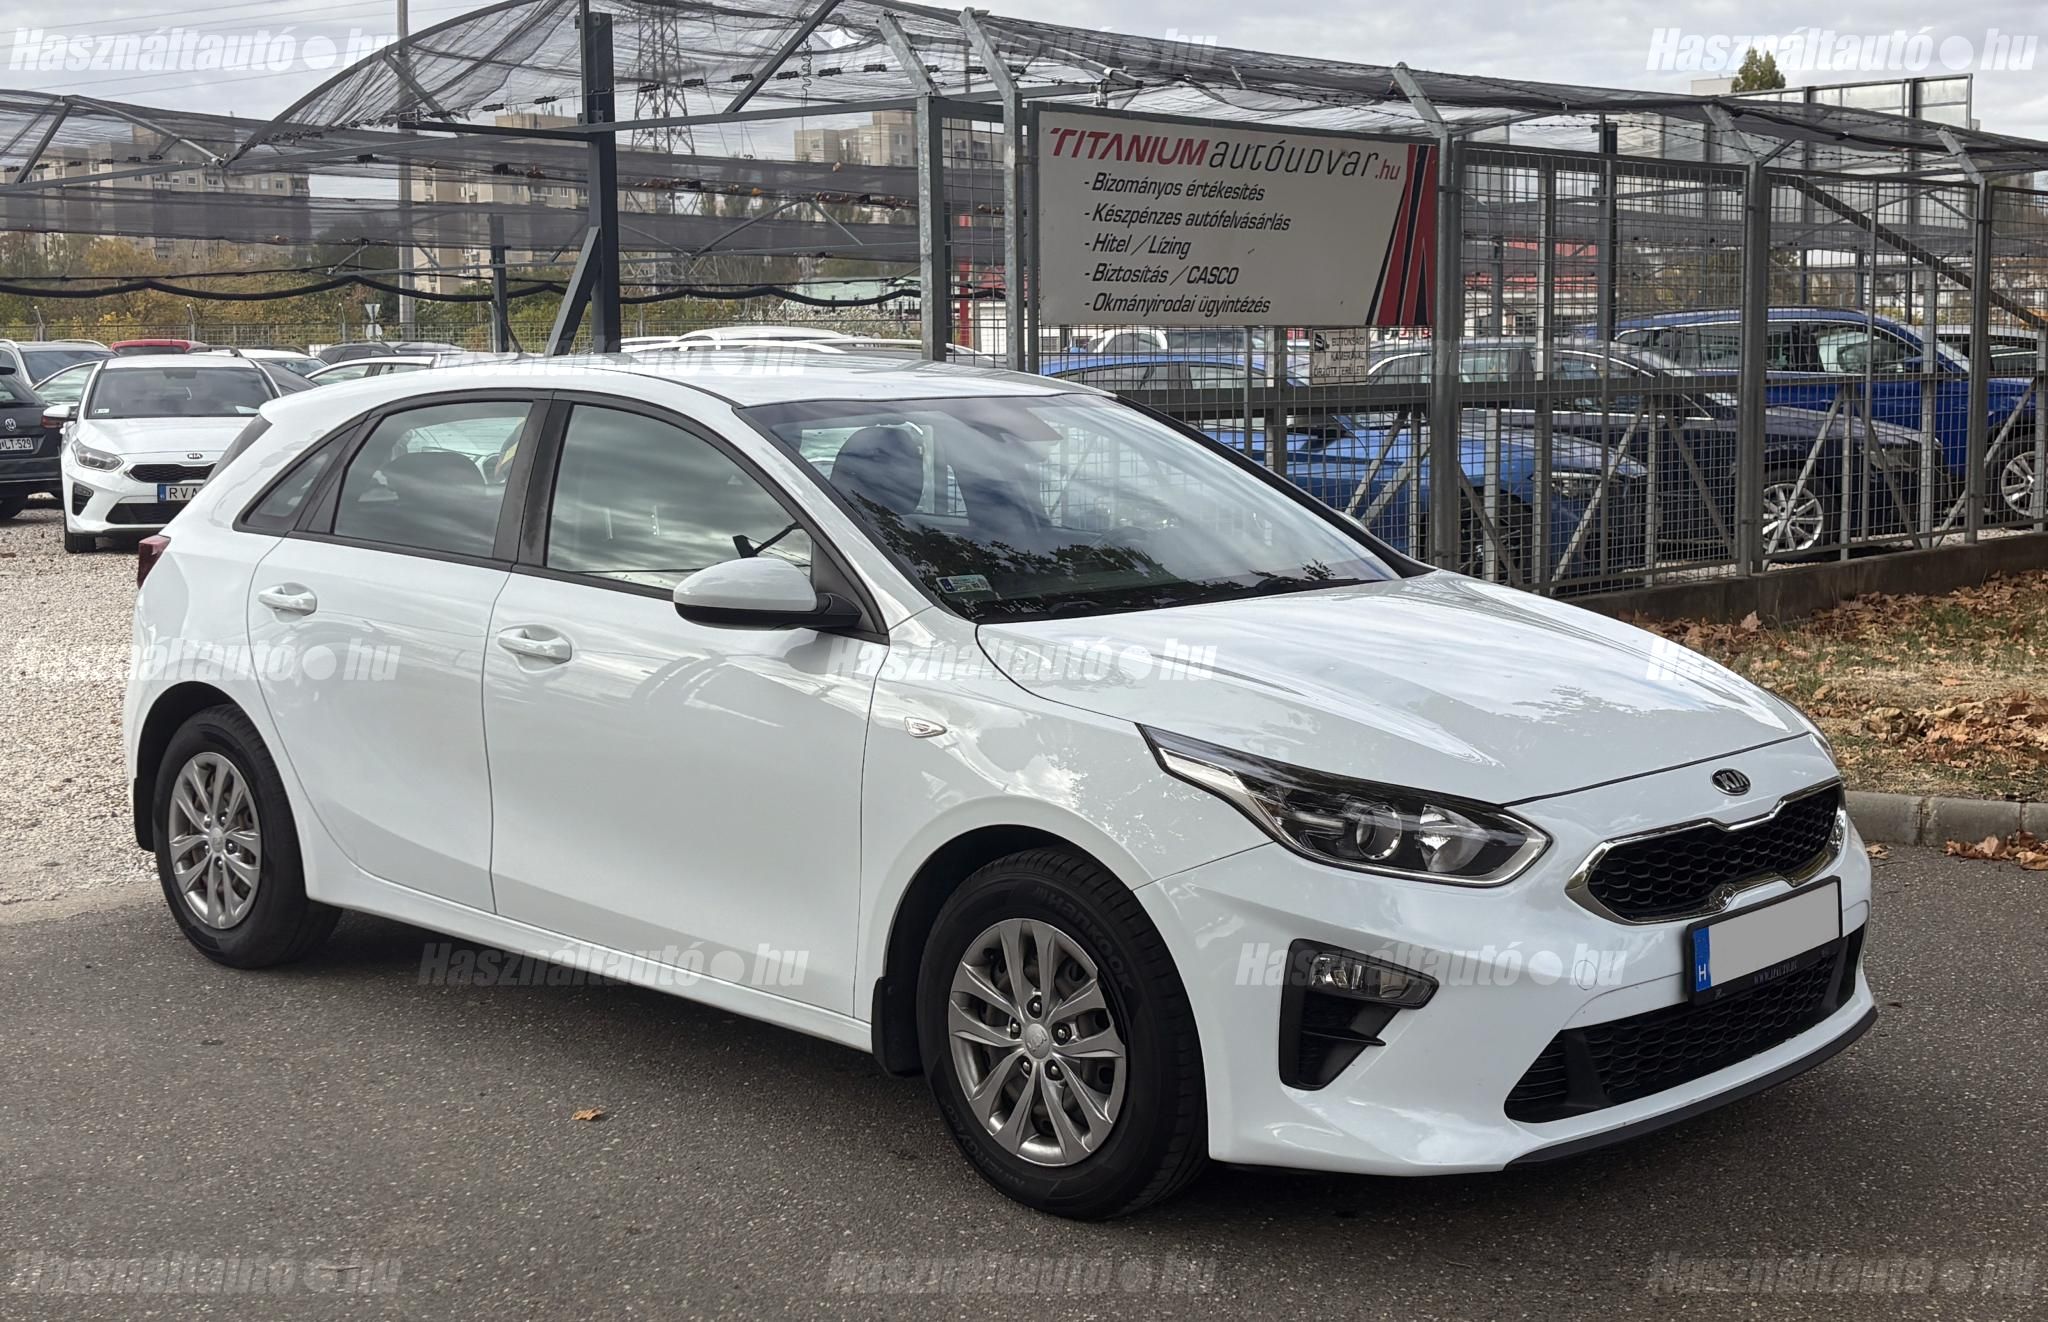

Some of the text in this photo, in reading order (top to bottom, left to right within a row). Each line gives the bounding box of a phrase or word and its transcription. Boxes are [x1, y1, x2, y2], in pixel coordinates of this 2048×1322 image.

[1186, 179, 1265, 201] értékesítés
[1185, 210, 1291, 231] autófelvásárlás
[1198, 295, 1271, 318] ügyintézés
[1714, 770, 1748, 792] KIA
[1697, 963, 1707, 982] H
